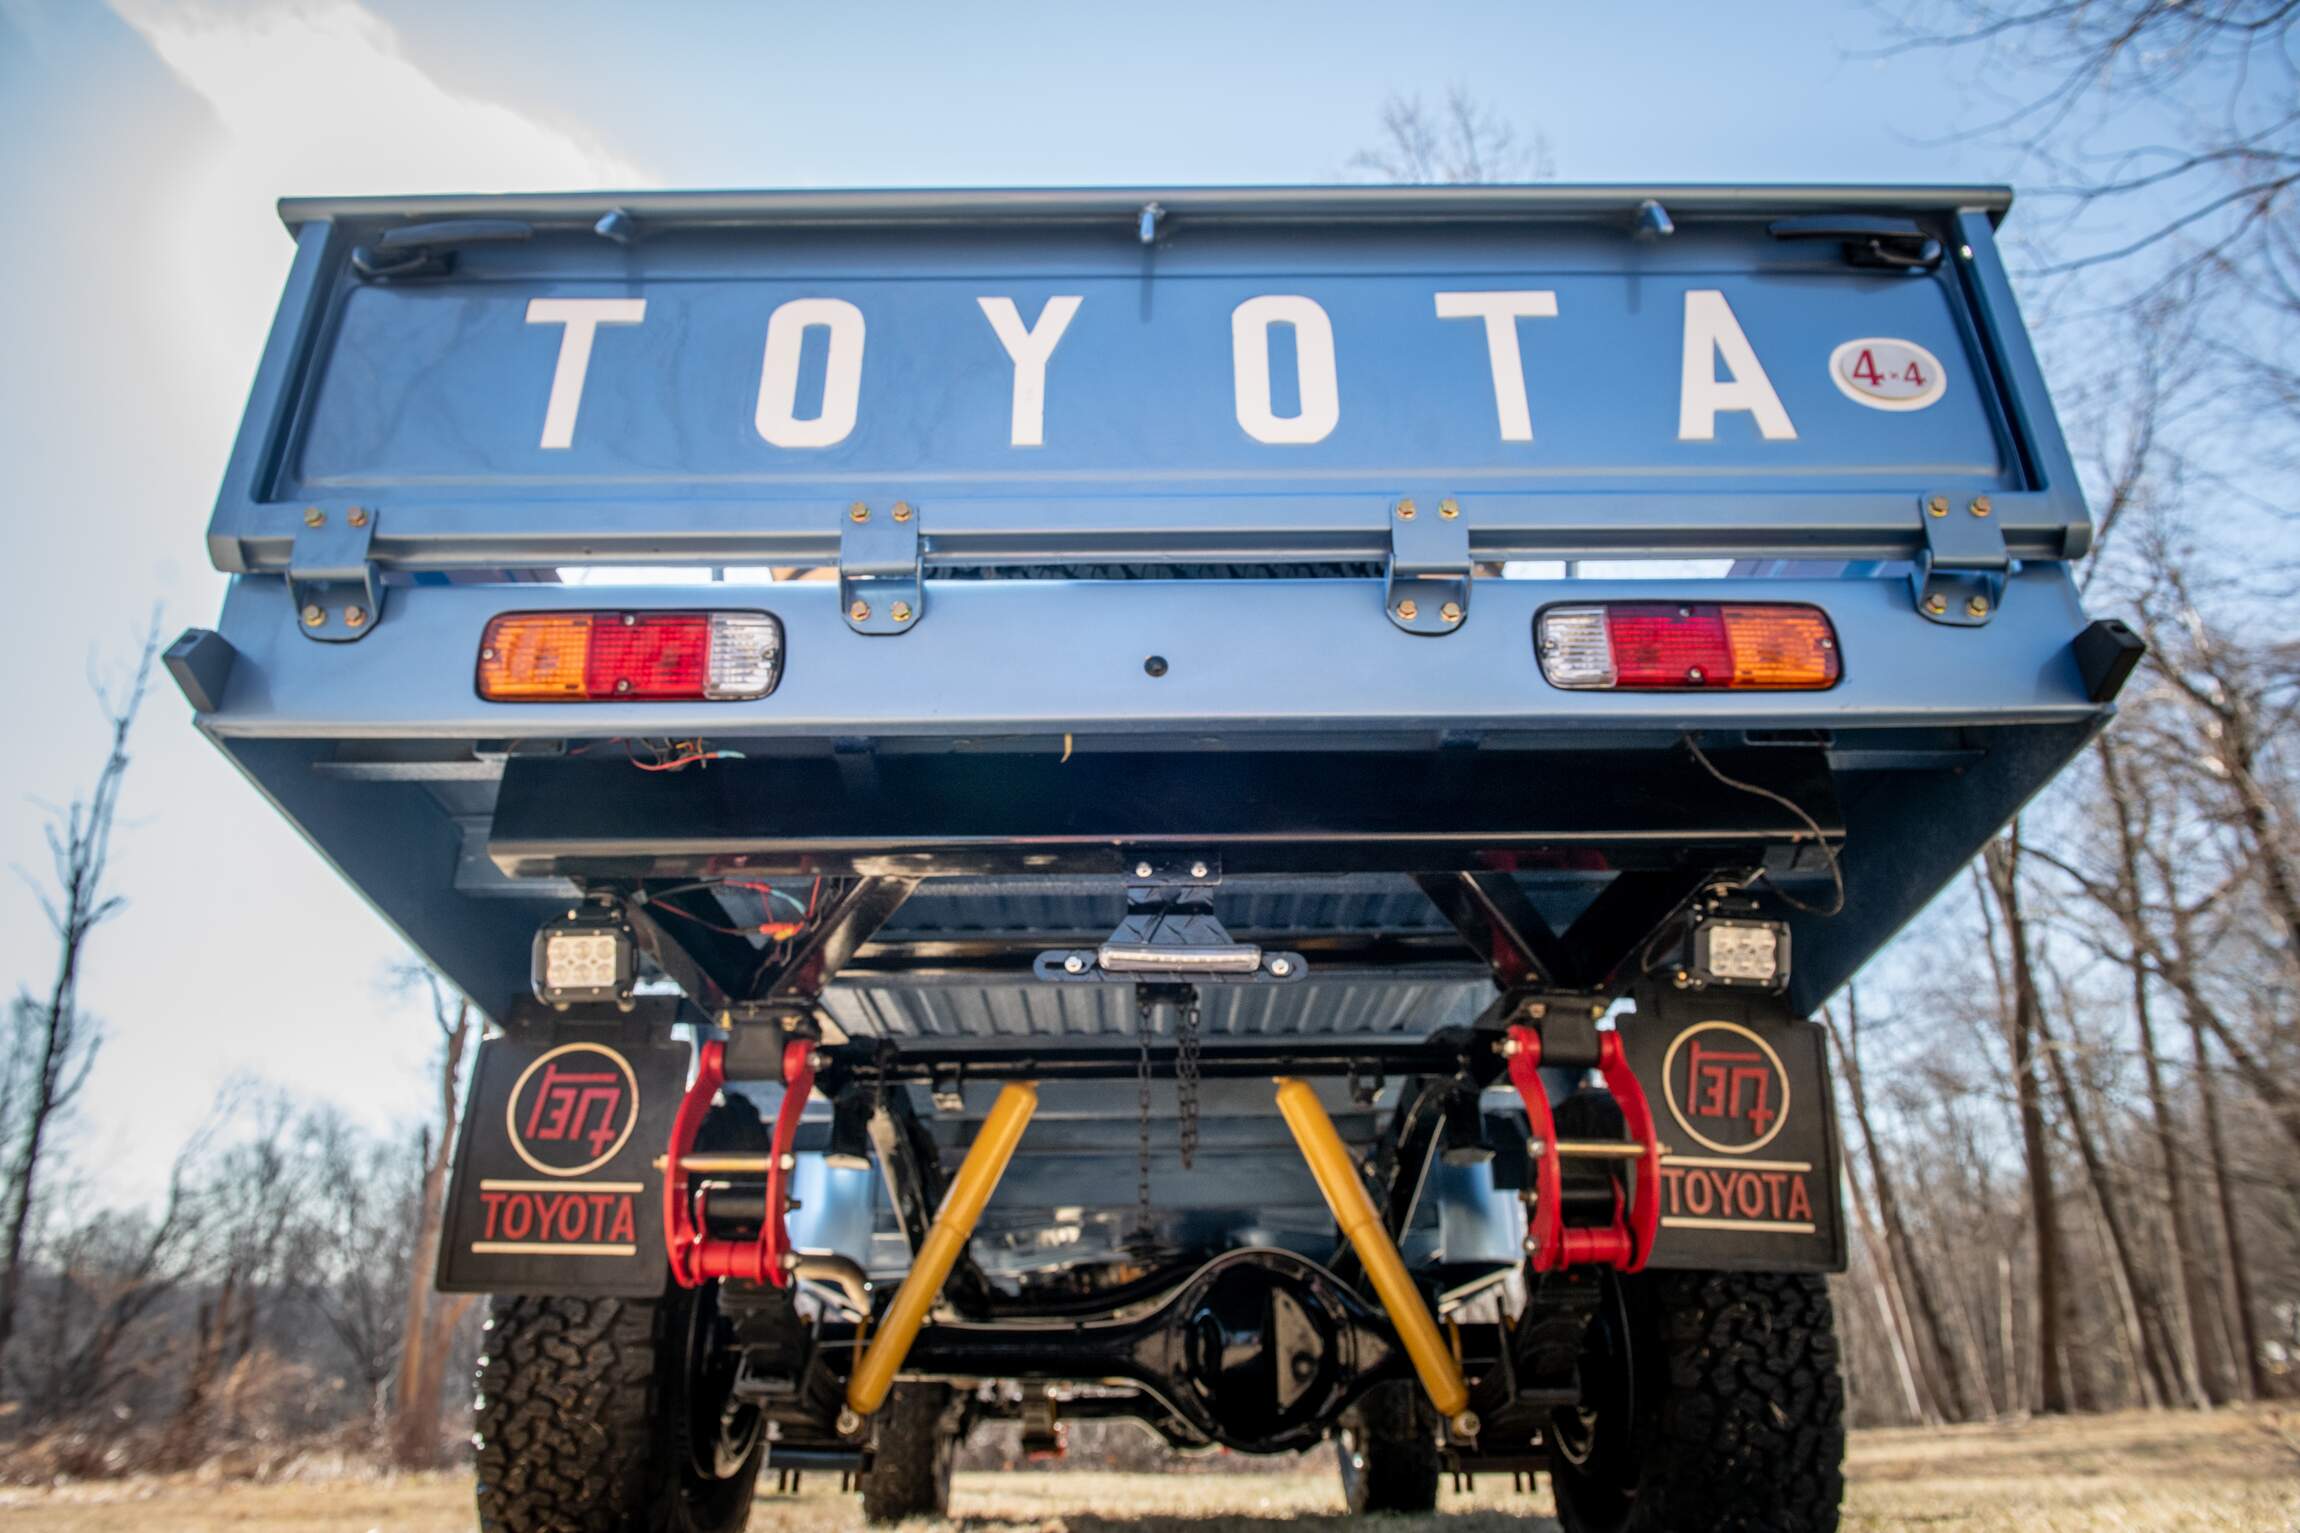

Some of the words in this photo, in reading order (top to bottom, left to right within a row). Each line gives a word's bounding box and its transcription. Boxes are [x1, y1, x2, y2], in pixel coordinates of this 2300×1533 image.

[525, 290, 1799, 450] TOYOTA
[479, 1192, 636, 1243] TOYOTA
[1659, 1167, 1814, 1220] TOYOTA
